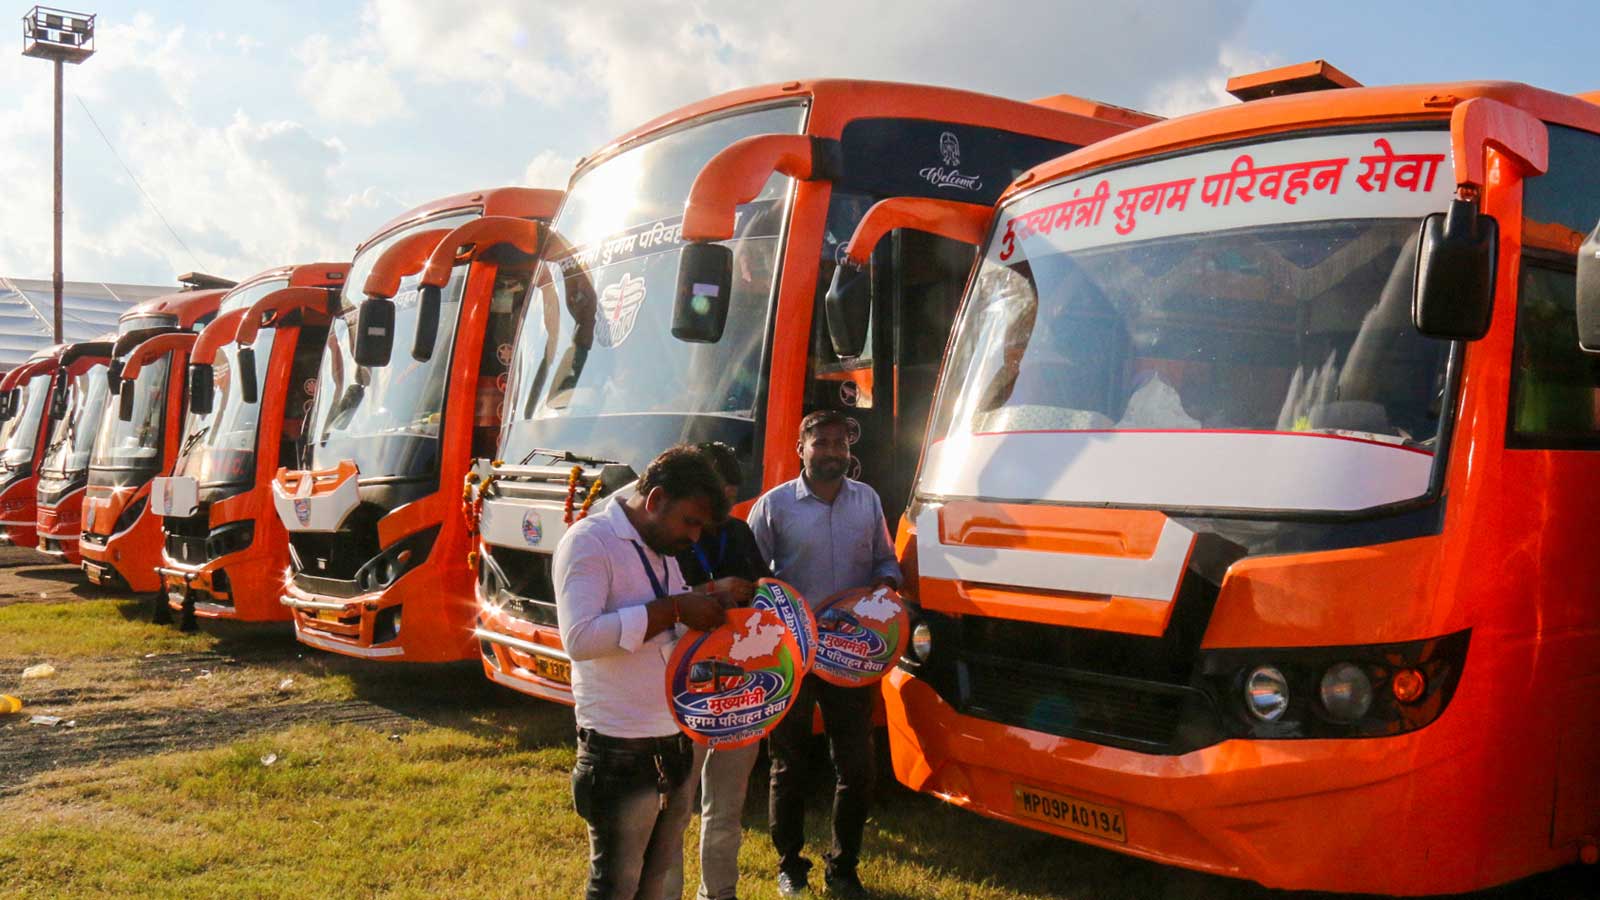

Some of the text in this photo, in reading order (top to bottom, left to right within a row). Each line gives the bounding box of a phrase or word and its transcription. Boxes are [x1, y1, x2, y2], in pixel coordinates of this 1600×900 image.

[919, 166, 983, 191] Welcome
[999, 137, 1446, 262] मुख्यमंत्री सुगम परिवहन सेवा
[639, 221, 684, 249] परिवह
[825, 634, 870, 658] मुख्यमंत्री
[826, 650, 862, 669] परिवहन
[863, 660, 884, 671] सेवा
[684, 699, 786, 729] सुगम परिवहन सेवा
[709, 686, 765, 714] मुख्यमंत्री
[1023, 792, 1122, 834] MP09PA0194
